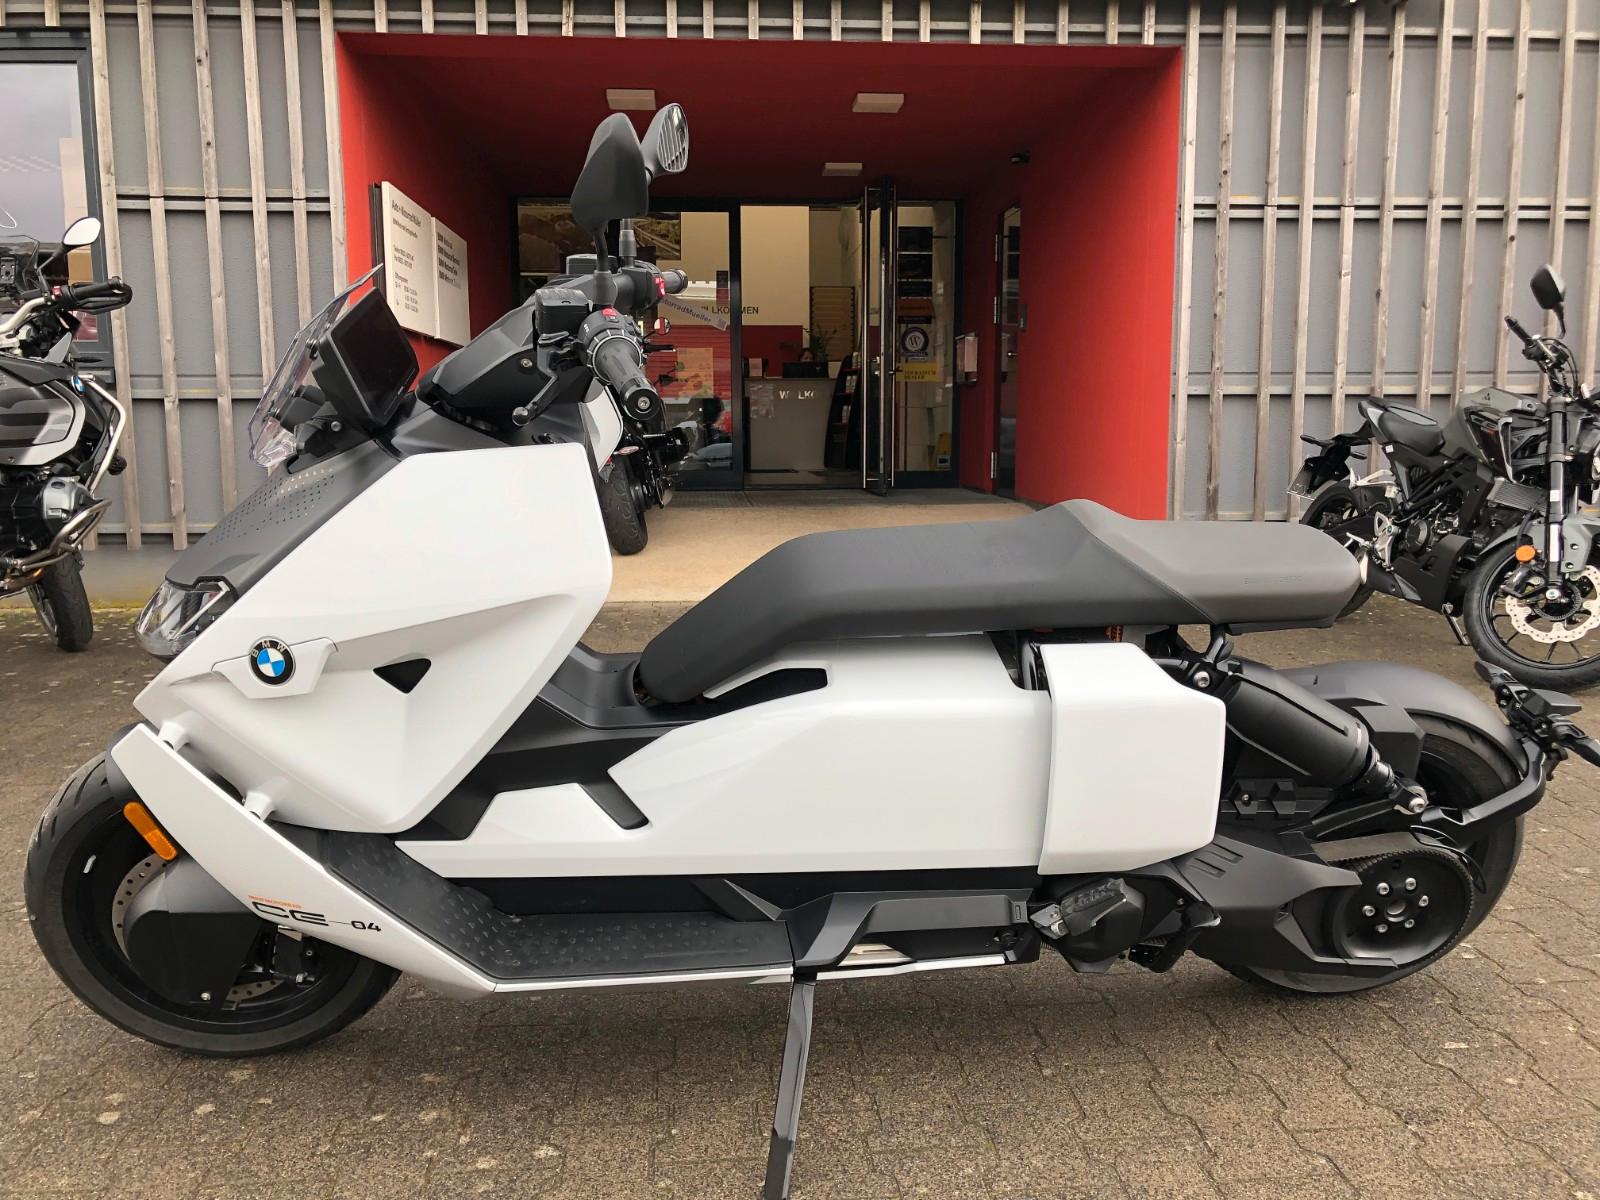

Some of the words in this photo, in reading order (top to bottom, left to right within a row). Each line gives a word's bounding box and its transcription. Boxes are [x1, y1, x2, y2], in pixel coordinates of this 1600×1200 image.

[251, 640, 287, 658] BMW
[252, 901, 329, 926] CE
[351, 920, 381, 932] 04
